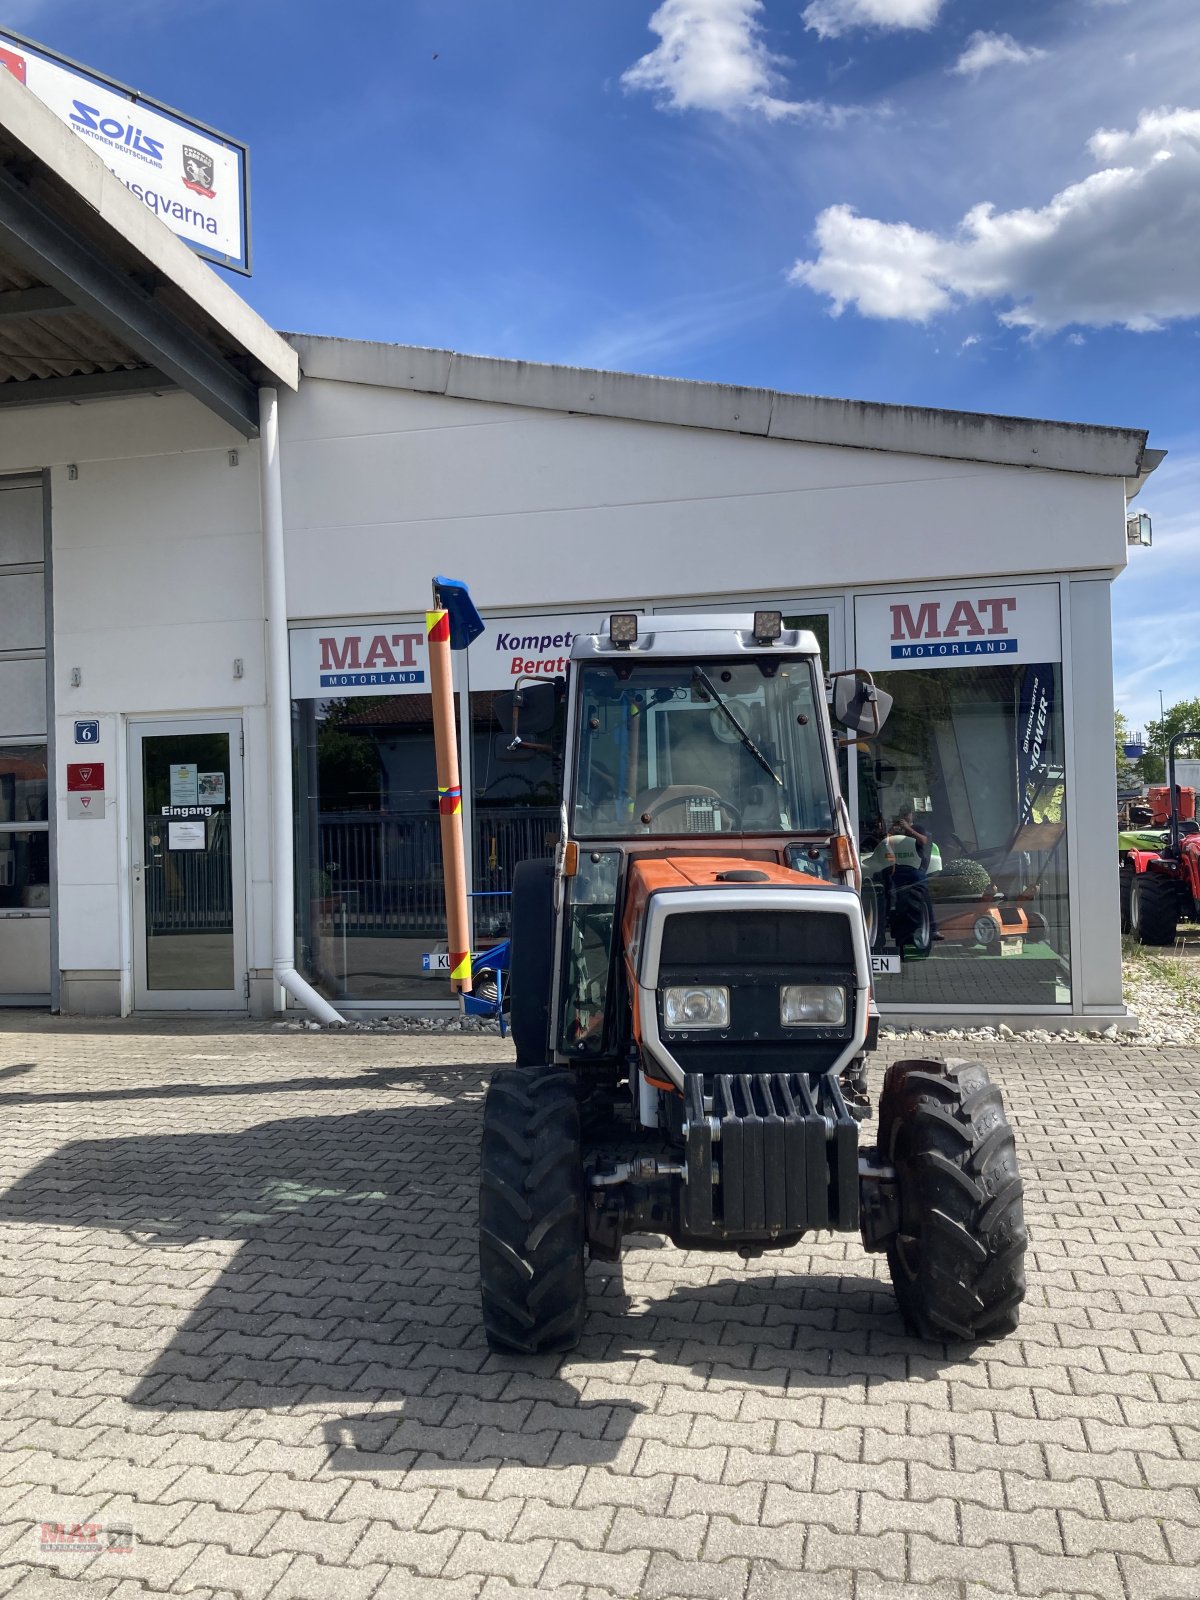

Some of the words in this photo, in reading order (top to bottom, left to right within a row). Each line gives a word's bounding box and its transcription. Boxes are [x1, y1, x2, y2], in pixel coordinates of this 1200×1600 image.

[72, 123, 113, 147] TRAKTOREN
[115, 143, 162, 169] DEUTSCHLAND
[890, 598, 1016, 640] MAT
[319, 634, 423, 670] MAT
[902, 642, 1007, 656] MOTORLAND
[329, 674, 416, 685] MOTORLAND
[82, 727, 92, 740] 6
[161, 806, 212, 817] Eingang
[871, 958, 889, 971] EN
